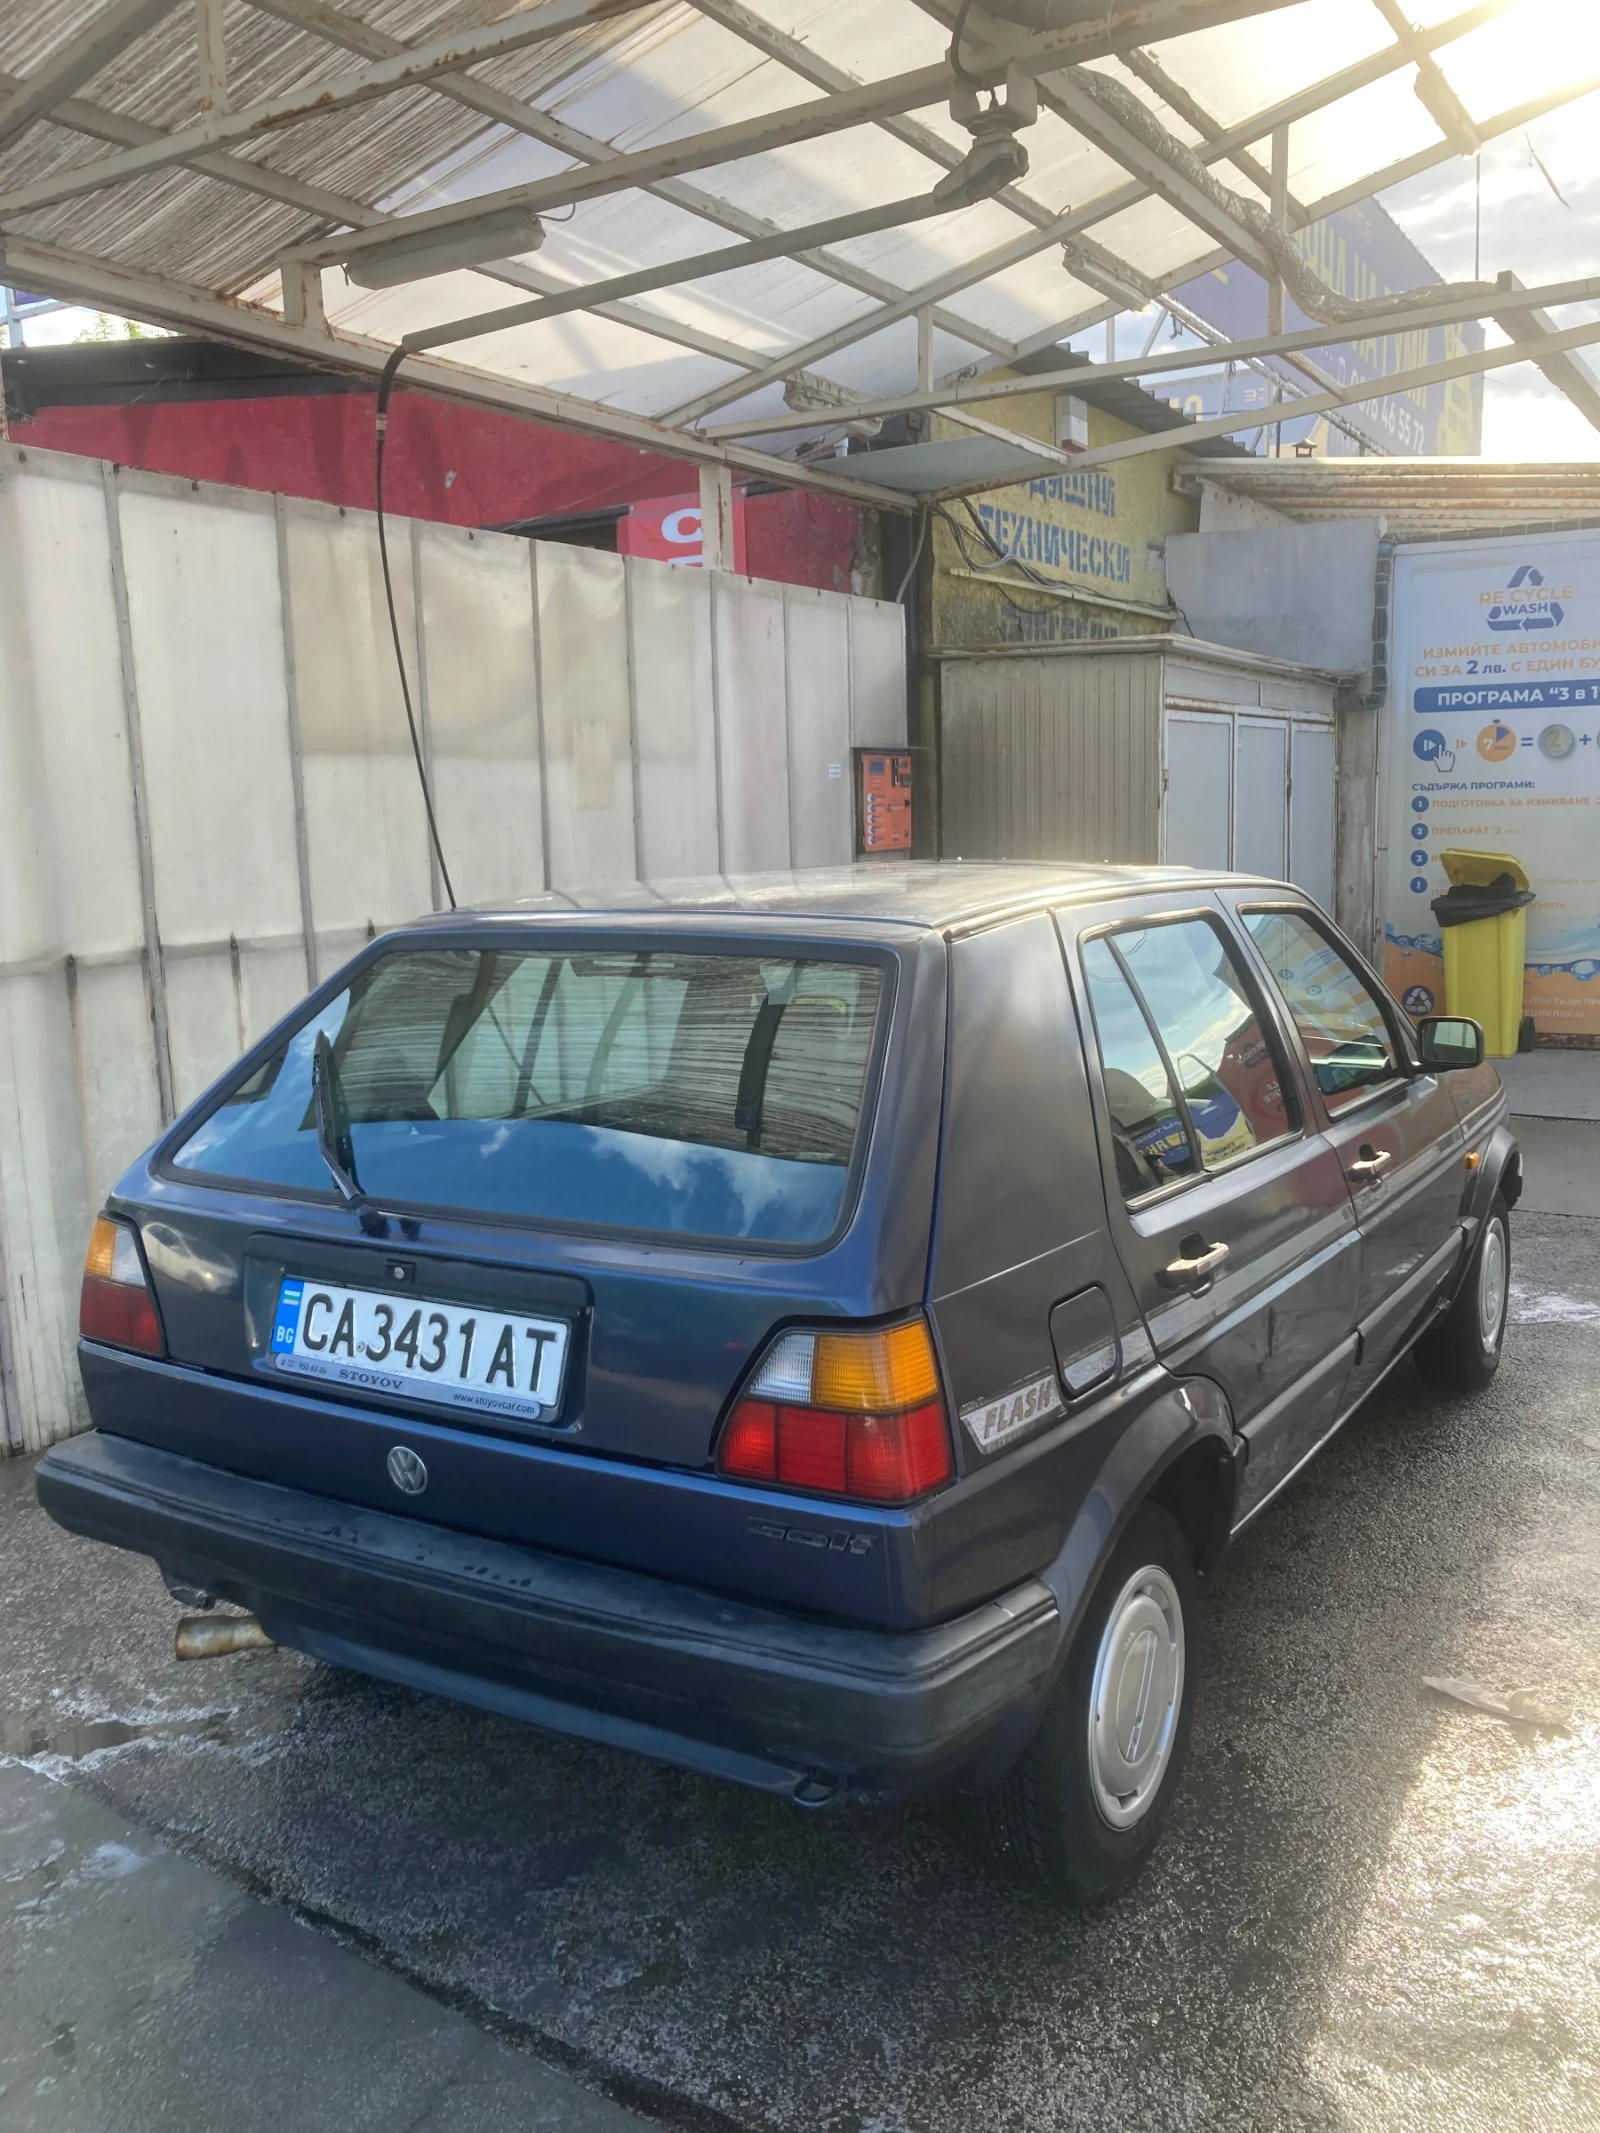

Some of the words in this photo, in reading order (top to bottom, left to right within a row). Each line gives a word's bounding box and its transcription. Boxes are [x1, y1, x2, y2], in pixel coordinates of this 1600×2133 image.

[1381, 396, 1395, 434] 46
[1398, 408, 1411, 446] 55
[1413, 419, 1425, 456] 72
[978, 503, 1131, 584] ТЕХНИЧЕСКИ
[1502, 603, 1548, 615] WASH
[1423, 643, 1501, 659] ИЗМИЙТЕ
[1414, 666, 1437, 678] СИ
[1441, 665, 1462, 676] ЗА
[1466, 660, 1479, 675] 2
[1511, 661, 1522, 672] С
[1526, 658, 1574, 673] ЕДИН
[1437, 688, 1544, 706] ПРОГРАМА
[1483, 738, 1493, 750] 7
[1432, 826, 1490, 835] ПРЕПАРАТ
[276, 1325, 295, 1344] BG
[339, 1368, 403, 1390] STOYOV
[453, 1392, 536, 1415] www.stoyovcar.com
[984, 1378, 1053, 1440] FLASH
